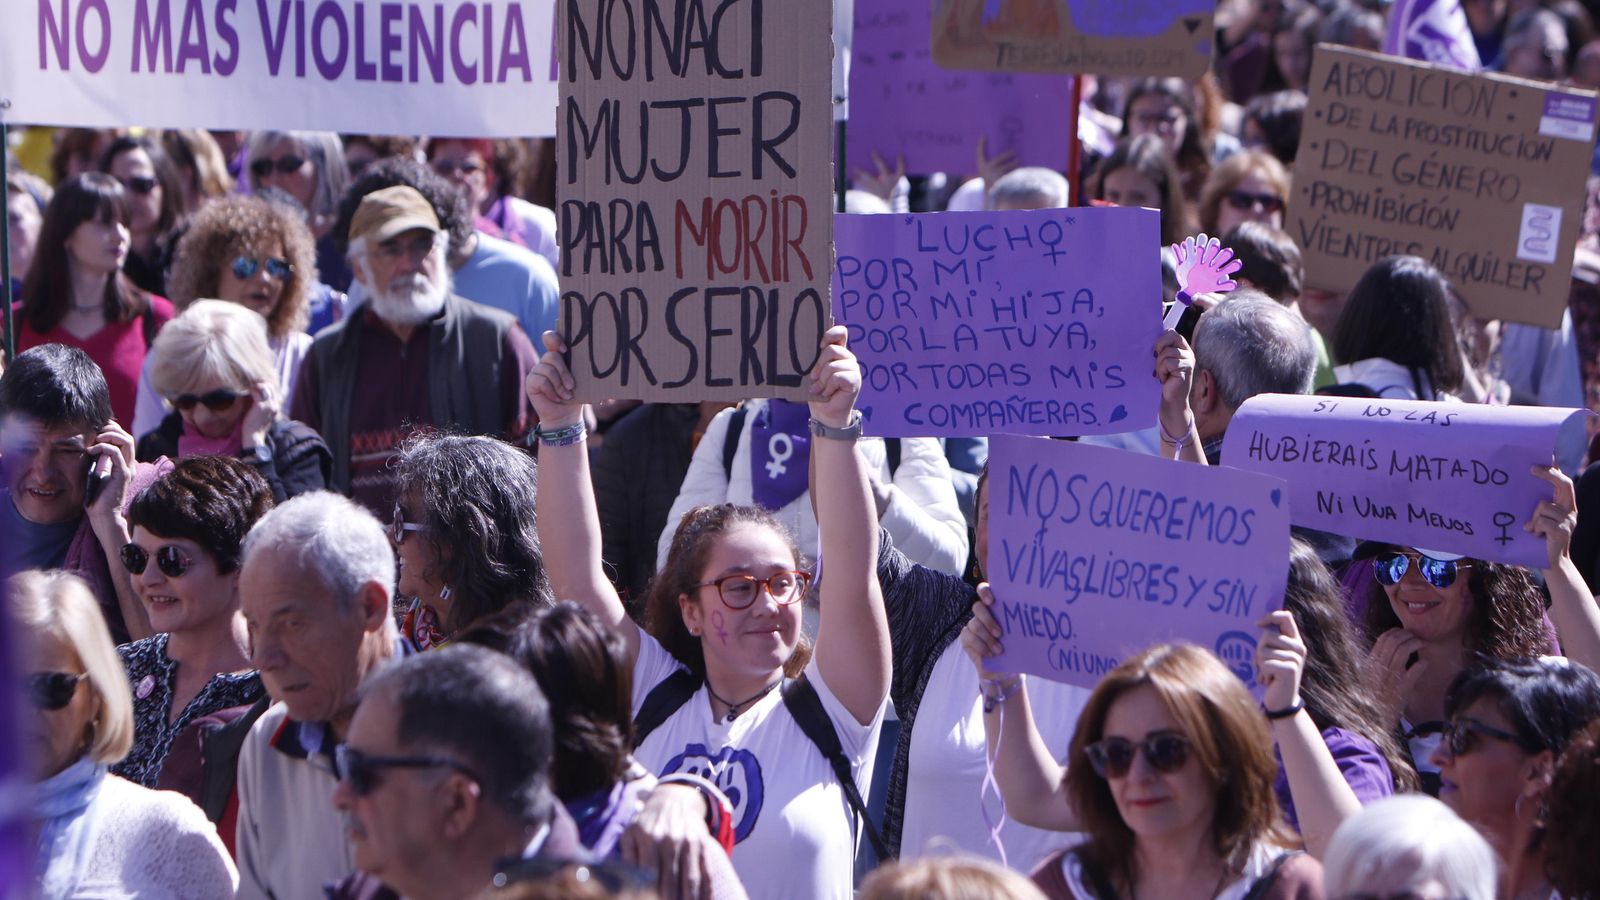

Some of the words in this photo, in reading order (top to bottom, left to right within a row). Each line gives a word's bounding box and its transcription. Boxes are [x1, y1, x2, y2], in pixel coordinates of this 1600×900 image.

[38, 0, 111, 73] NO
[256, 0, 531, 85] VIOLENCIA
[567, 0, 636, 82] NO
[1327, 101, 1361, 129] DE
[1370, 112, 1398, 136] LA
[567, 91, 800, 185] MUJER
[1321, 138, 1383, 178] DEL
[1392, 151, 1521, 202] GÉNERO
[562, 199, 664, 277] PARA
[837, 256, 918, 291] POR
[840, 290, 918, 321] POR
[562, 286, 658, 386] POR
[662, 286, 824, 389] SERLO
[846, 324, 912, 352] POR
[920, 324, 978, 352] LA
[984, 322, 1097, 351] TUYA,
[918, 362, 1031, 390] TODAS
[1313, 400, 1339, 413] SI
[1362, 404, 1391, 417] NO
[1404, 410, 1458, 427] LAS
[1390, 454, 1509, 486] MATADO
[1007, 463, 1087, 526] NOS
[1089, 481, 1255, 546] QUEREMOS
[1408, 507, 1474, 536] MENOS
[1183, 574, 1207, 608] Y
